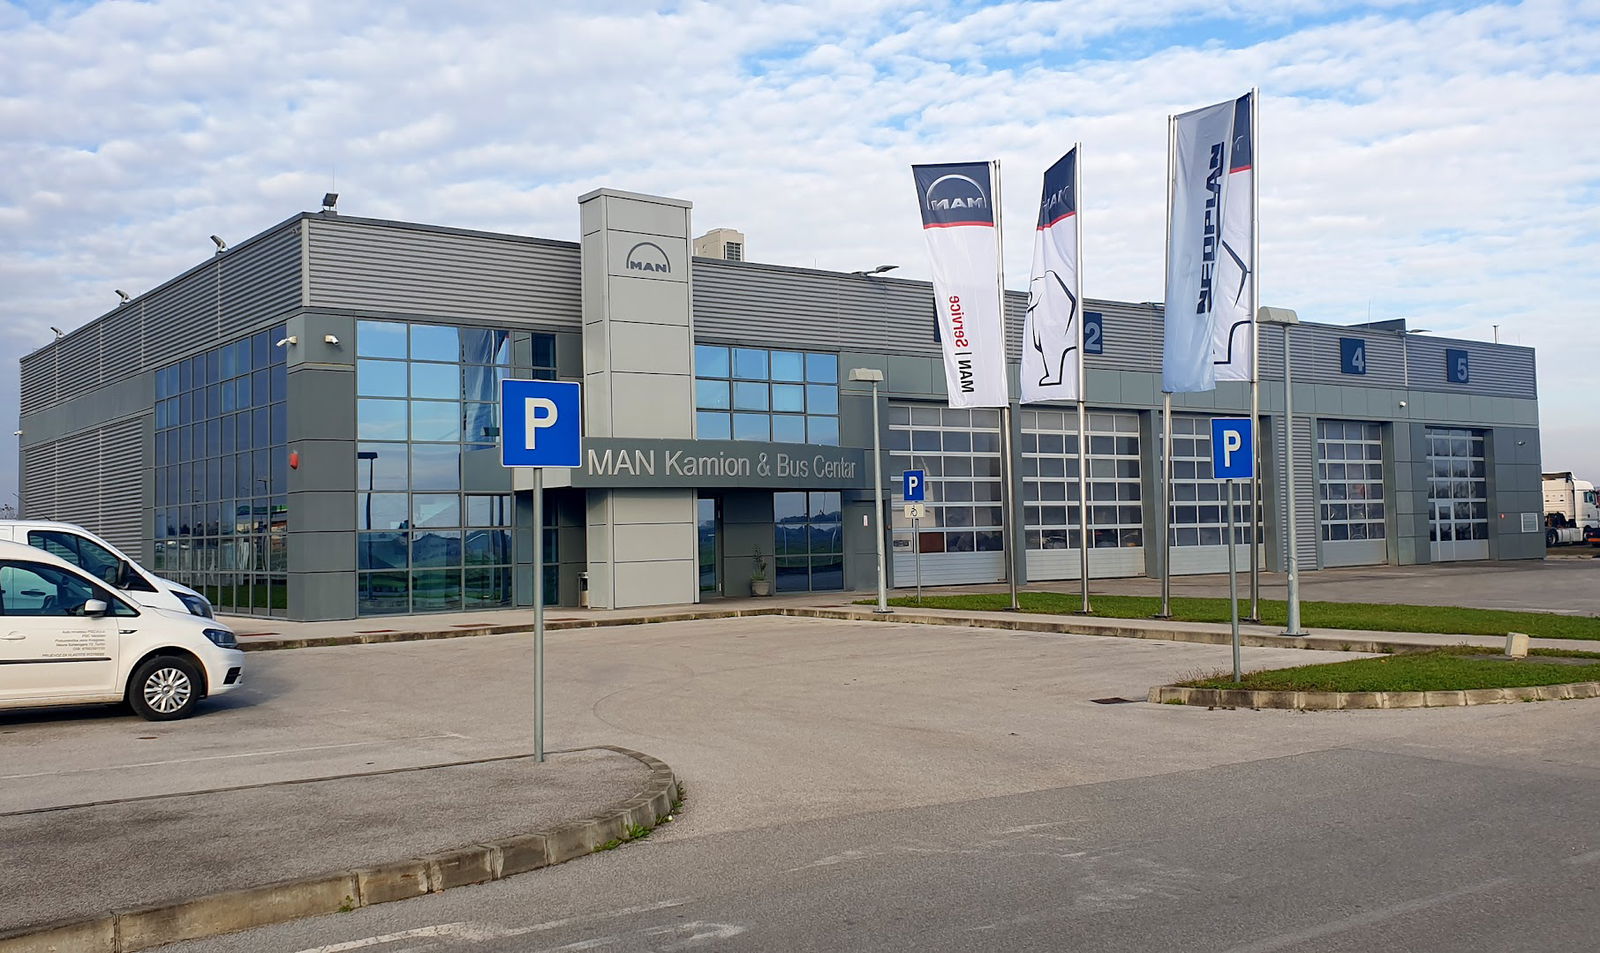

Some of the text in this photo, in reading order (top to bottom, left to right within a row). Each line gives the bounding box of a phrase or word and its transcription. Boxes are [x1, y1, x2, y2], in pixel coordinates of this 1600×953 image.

[1197, 141, 1224, 314] NEOPLAN
[630, 260, 667, 273] MAN
[1085, 322, 1101, 350] 2
[1352, 347, 1365, 372] 4
[1457, 357, 1468, 381] 5
[525, 397, 559, 450] P
[1224, 430, 1242, 468] P
[588, 449, 856, 479] MAN Kamion & Bus Centar
[908, 475, 919, 496] P
